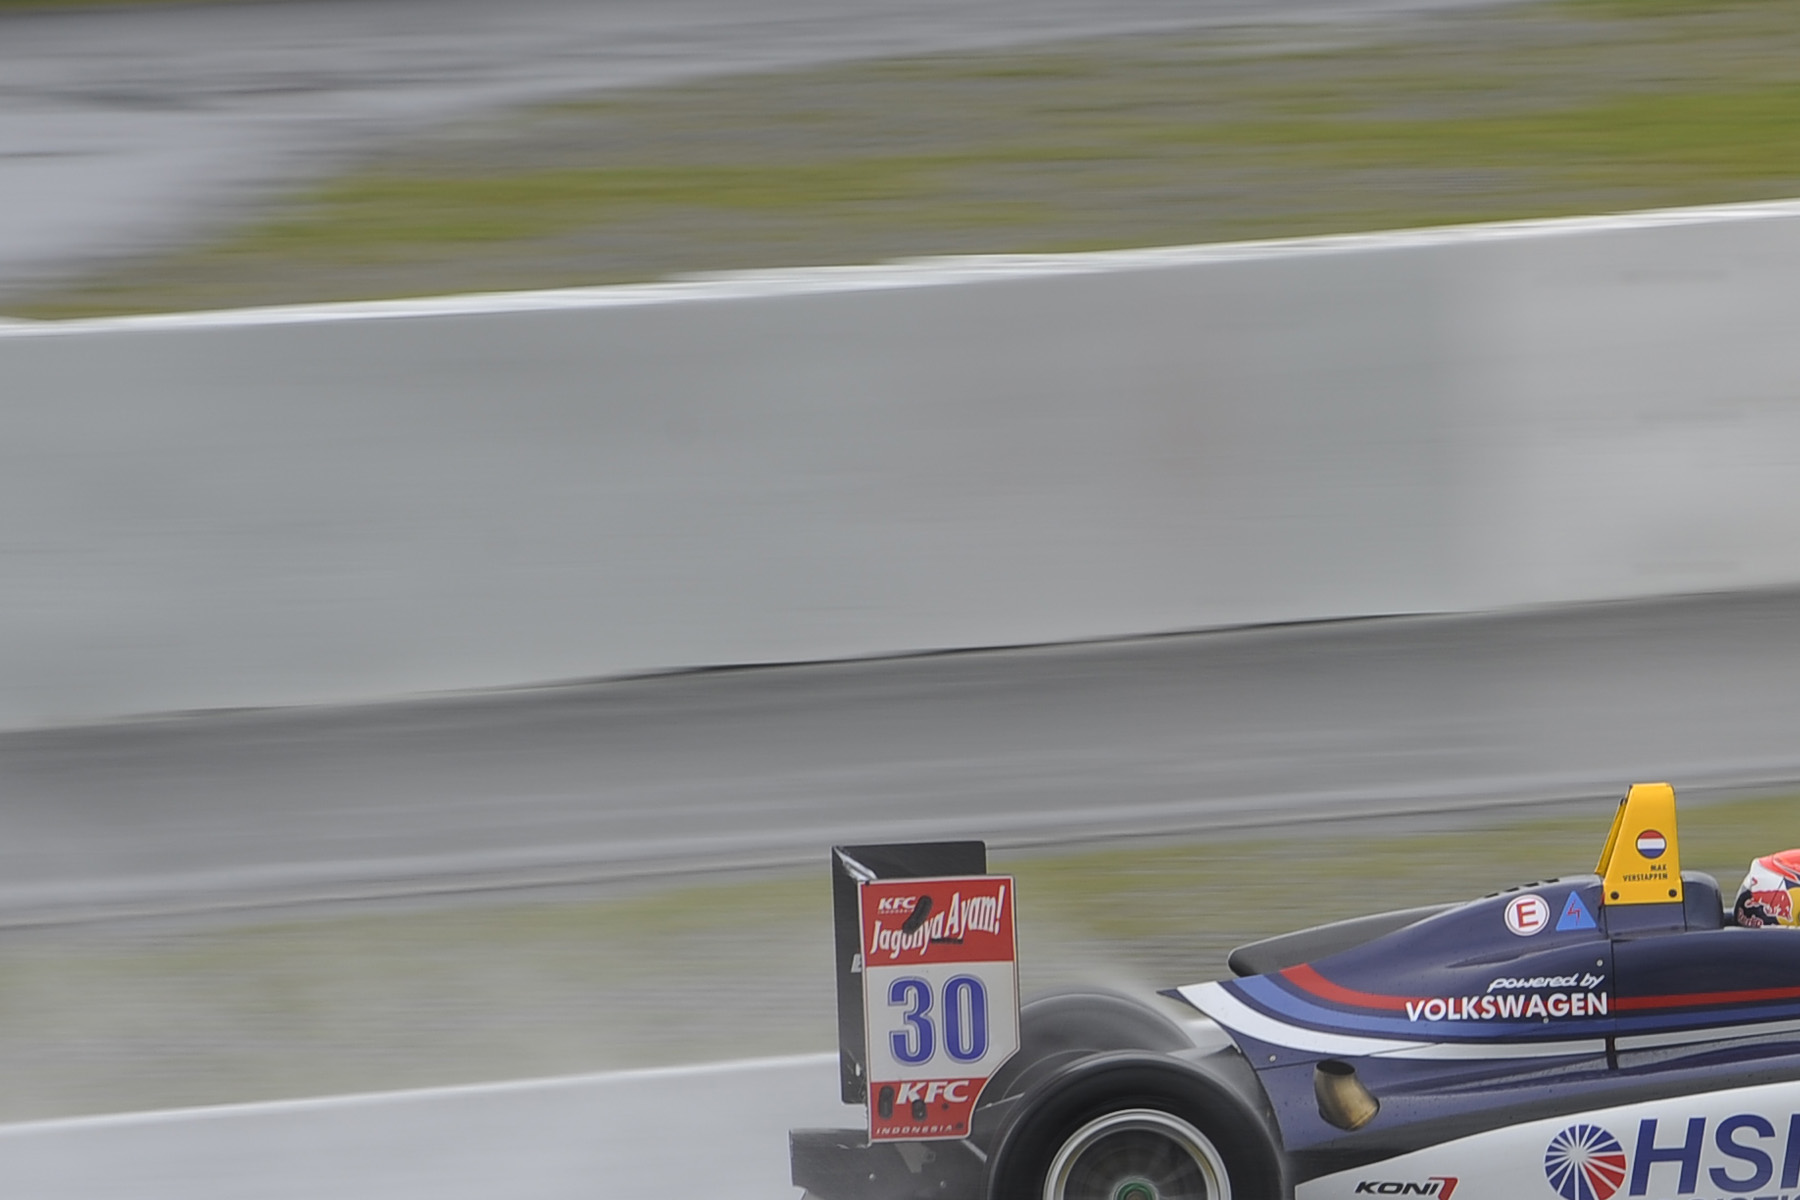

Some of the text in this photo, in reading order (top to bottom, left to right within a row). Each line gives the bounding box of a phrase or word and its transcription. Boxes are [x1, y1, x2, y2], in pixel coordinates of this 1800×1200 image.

[1623, 873, 1668, 881] VERSTAPPEN
[878, 896, 916, 910] KFC
[944, 885, 1005, 940] Ayam!
[1516, 901, 1539, 928] E
[1486, 973, 1605, 993] powered by
[1405, 992, 1608, 1022] VOLKSWAGEN
[887, 973, 990, 1067] 30
[896, 1080, 970, 1105] KFC
[876, 1124, 953, 1135] INDONESIA
